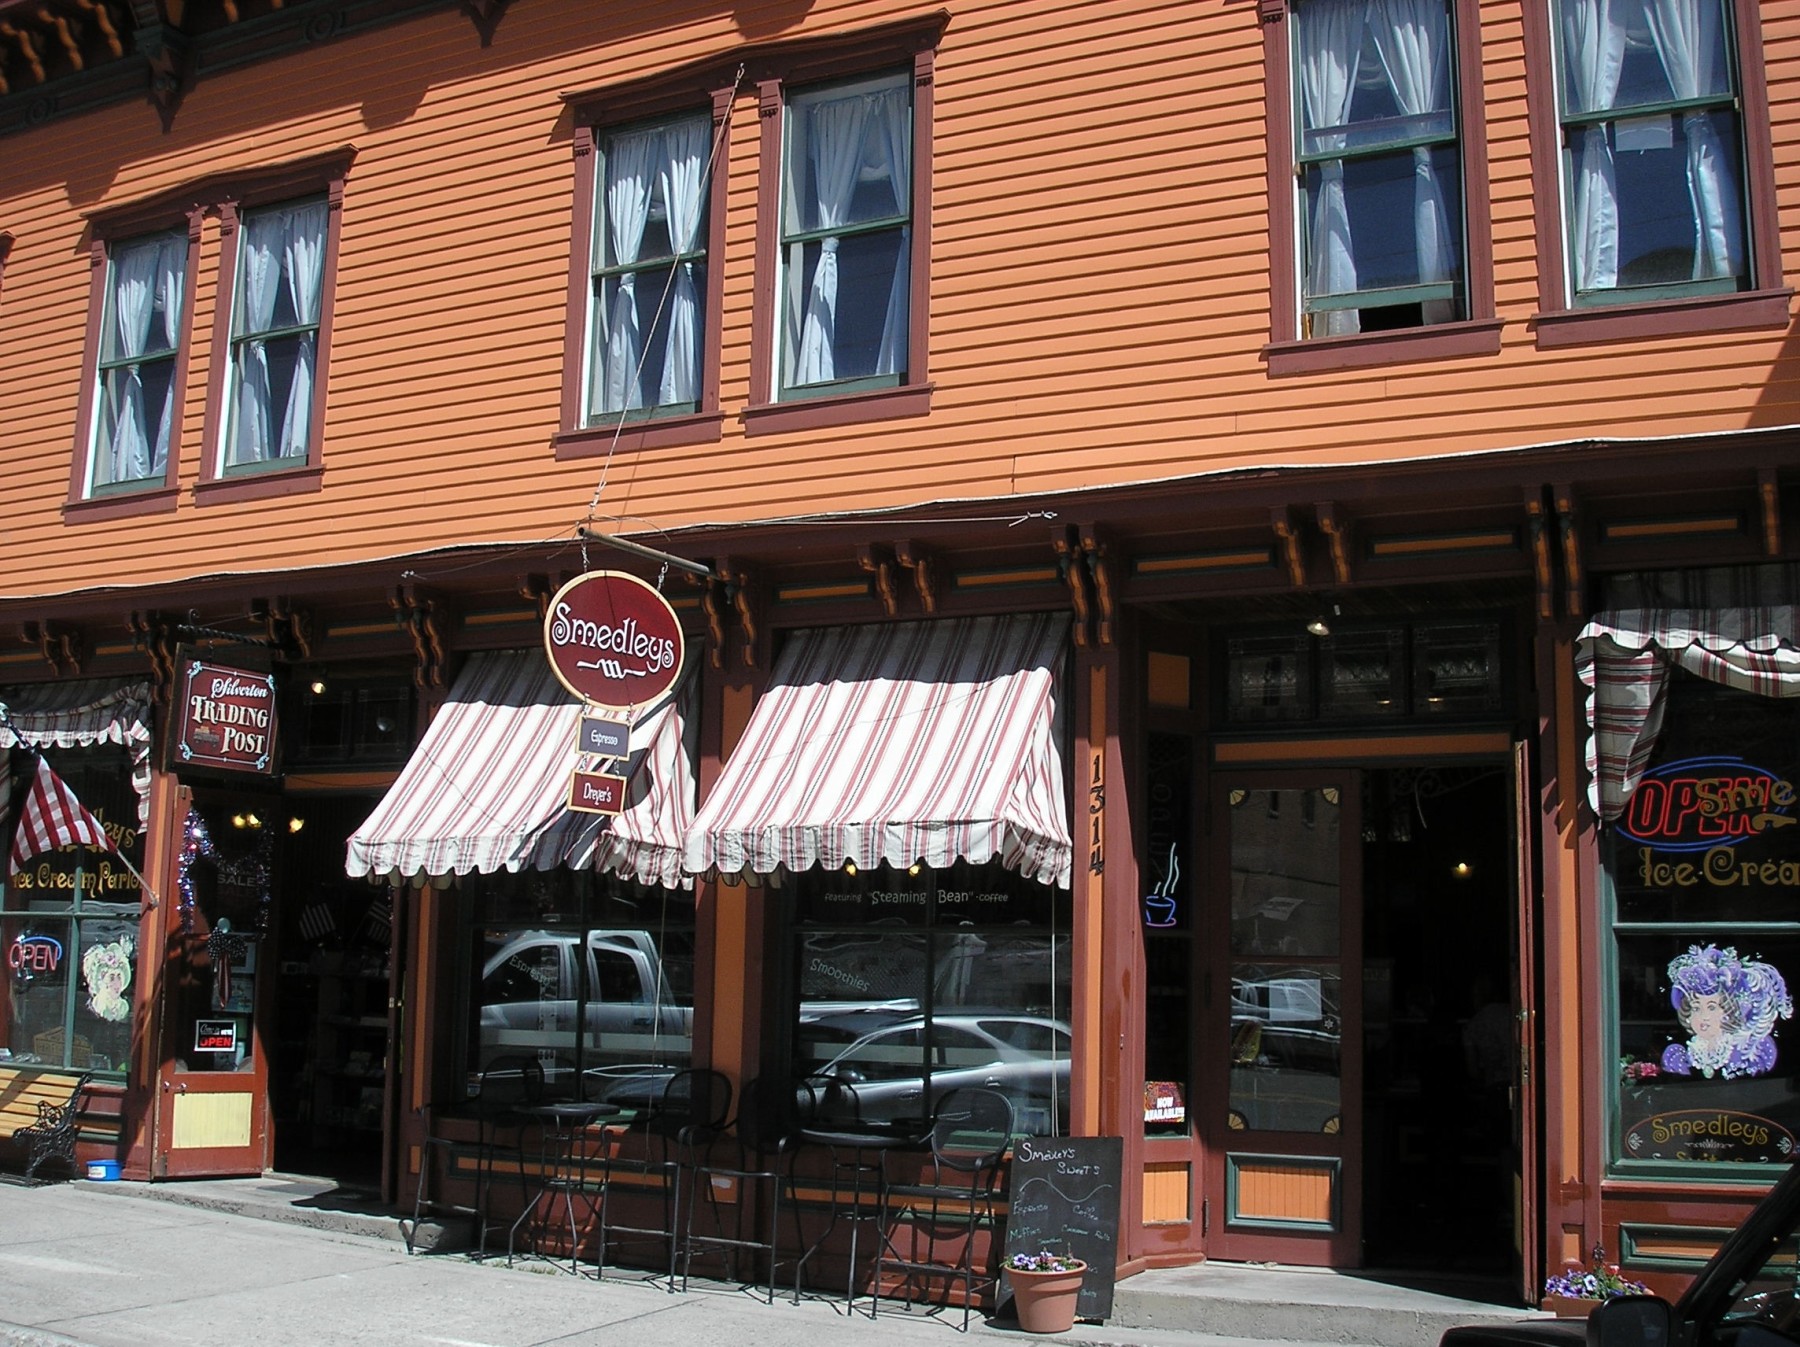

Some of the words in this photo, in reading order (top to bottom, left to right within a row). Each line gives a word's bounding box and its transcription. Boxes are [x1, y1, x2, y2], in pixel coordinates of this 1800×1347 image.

[551, 602, 675, 673] Smedleys
[211, 678, 268, 698] Silverton
[190, 695, 269, 728] TRADING
[220, 726, 266, 754] POST
[590, 729, 618, 746] Espresso
[583, 782, 612, 806] Dreyer's
[1628, 777, 1771, 836] OPEN
[1089, 755, 1105, 876] 1314
[217, 873, 256, 887] SALE
[1638, 847, 1699, 886] Ice
[824, 892, 862, 902] featuring
[10, 943, 58, 971] OPEN
[809, 958, 871, 992] Smoothies
[200, 1037, 232, 1047] OPEN
[1652, 1114, 1769, 1145] Smedleys
